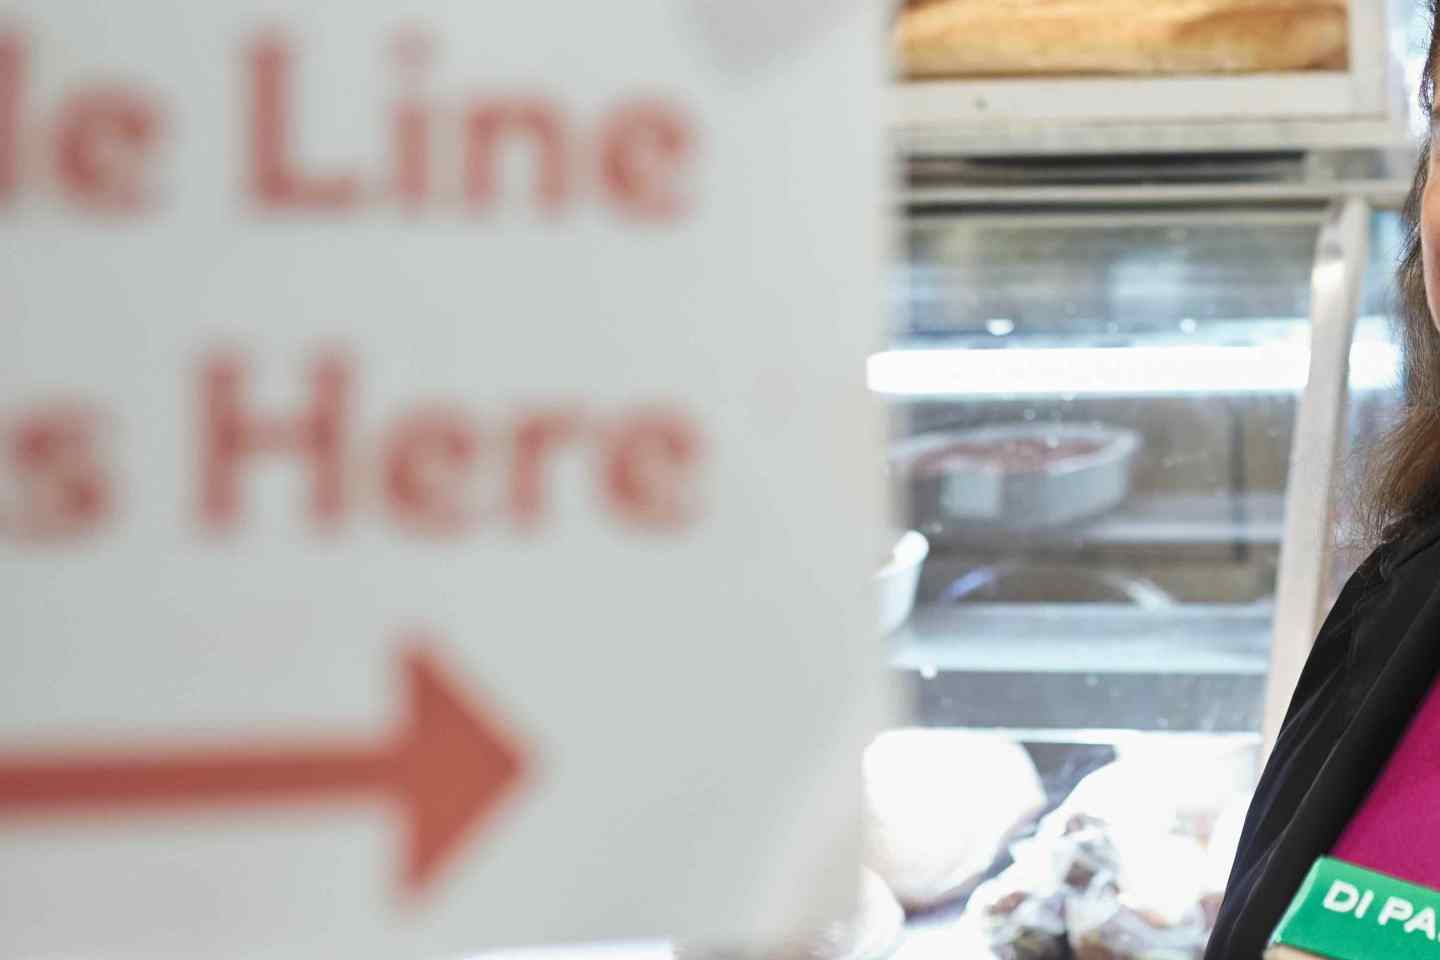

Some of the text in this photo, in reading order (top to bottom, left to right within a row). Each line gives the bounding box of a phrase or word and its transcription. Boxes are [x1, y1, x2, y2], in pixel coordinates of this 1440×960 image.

[244, 28, 698, 222] Line
[198, 348, 704, 532] Here
[1323, 880, 1374, 919] DI
